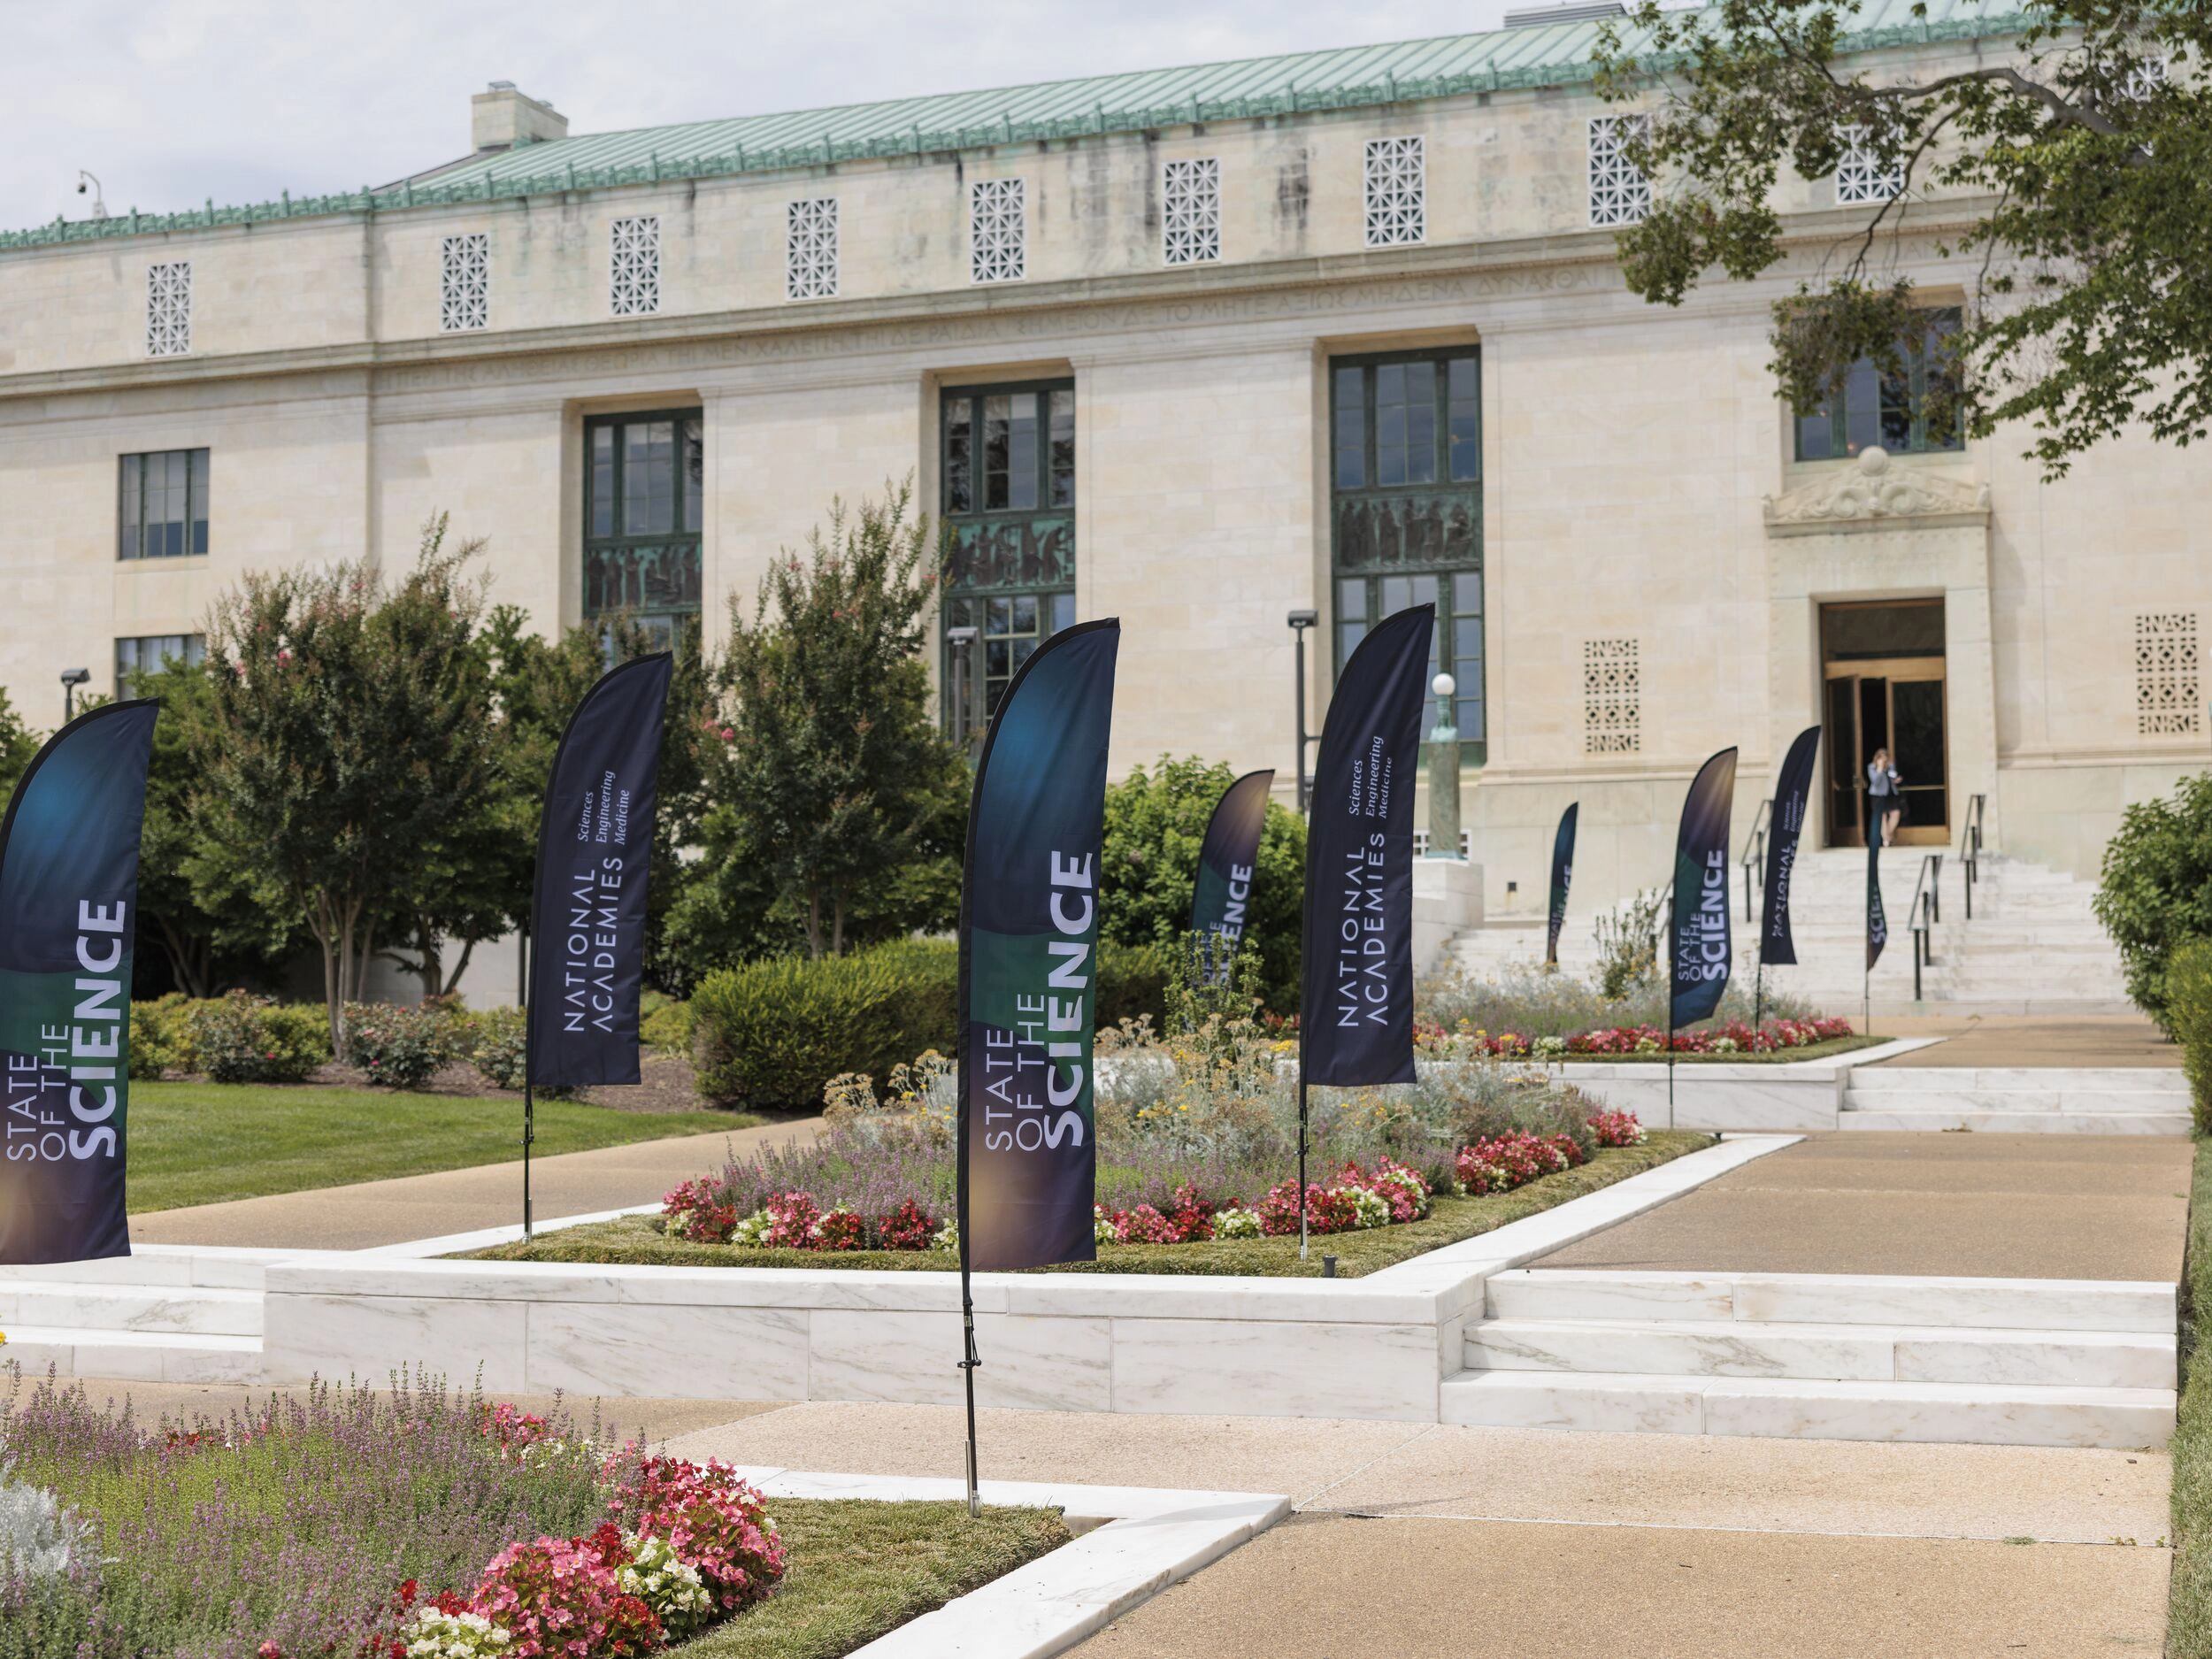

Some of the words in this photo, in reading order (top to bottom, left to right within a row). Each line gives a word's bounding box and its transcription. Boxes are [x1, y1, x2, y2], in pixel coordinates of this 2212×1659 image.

[595, 771, 617, 844] Engineering
[1348, 758, 1363, 816] Sciences
[1365, 735, 1385, 817] Engineering
[1379, 757, 1393, 818] Medicine
[578, 791, 594, 843] Sciences
[615, 789, 631, 846] Medicine
[564, 868, 595, 1032] NATIONAL
[591, 856, 623, 1033] ACADEMIES
[1337, 846, 1365, 1027] NATIONAL
[1363, 832, 1389, 1026] ACADEMIES
[1689, 912, 1701, 947] THE
[1701, 849, 1726, 981] SCIENCE
[1678, 927, 1691, 981] STATE
[1688, 956, 1701, 982] OF
[68, 899, 127, 1161] SCIENCE
[1017, 993, 1045, 1072] THE
[1044, 850, 1094, 1150] SCIENCE
[41, 1024, 69, 1087] THE
[985, 1029, 1014, 1151] STATE
[7, 1055, 38, 1163] STATE
[40, 1110, 67, 1162] OF
[1016, 1093, 1044, 1152] OF
